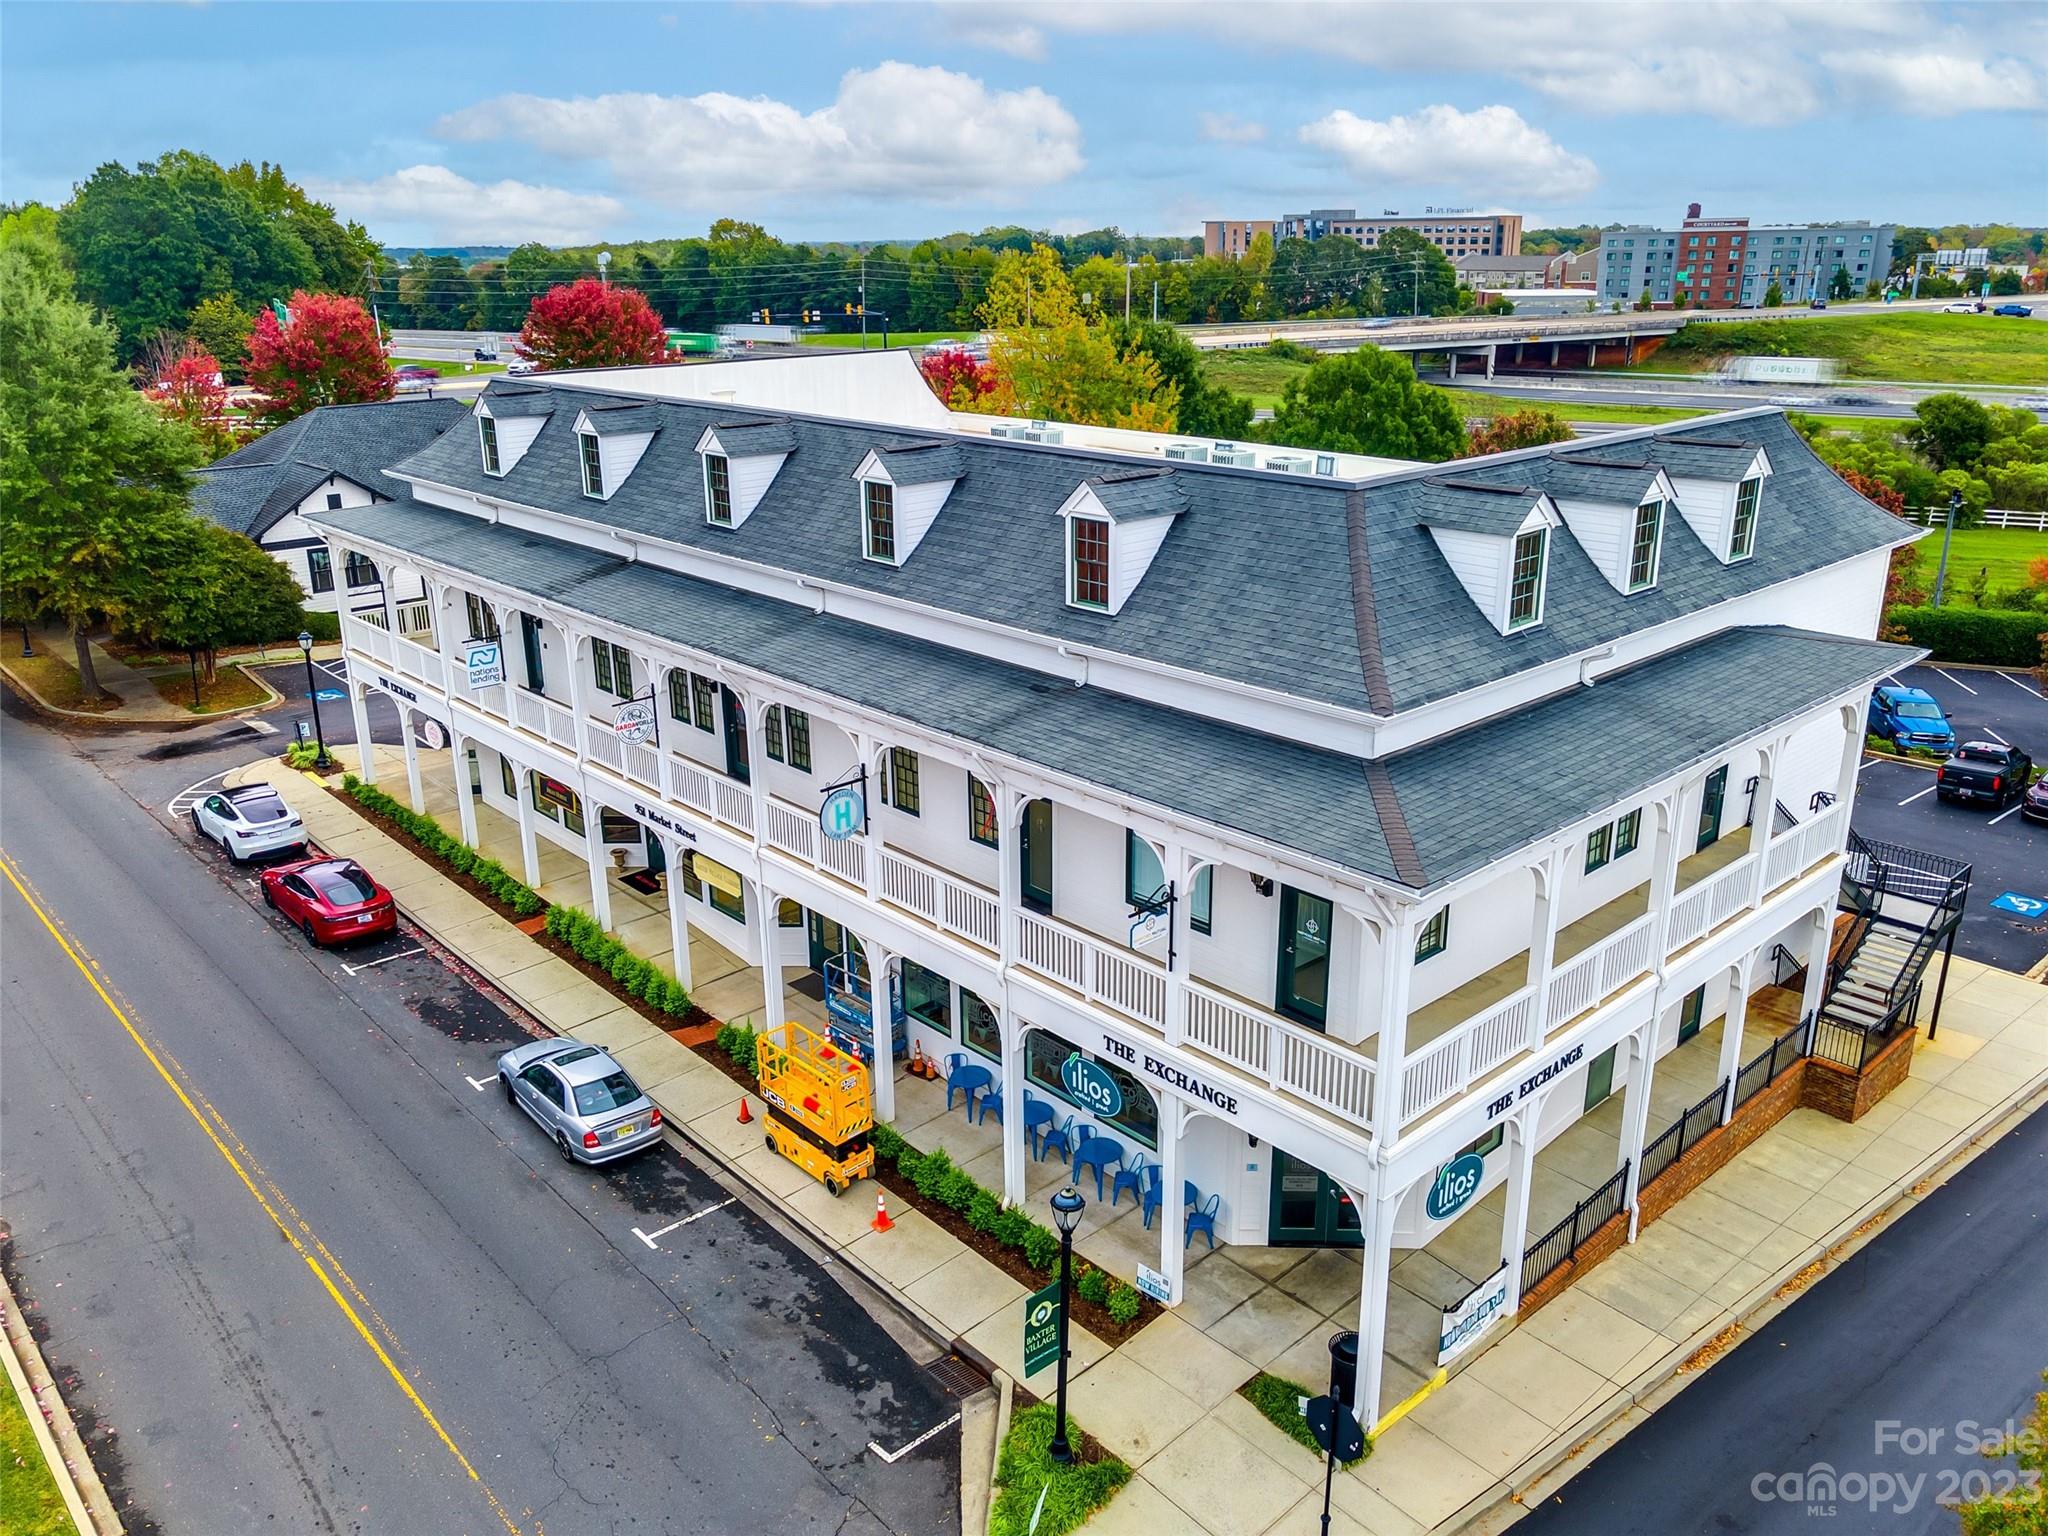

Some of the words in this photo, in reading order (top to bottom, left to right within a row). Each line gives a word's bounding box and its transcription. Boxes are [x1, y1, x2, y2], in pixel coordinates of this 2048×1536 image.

[470, 666, 500, 678] nations
[471, 673, 500, 684] lending
[647, 809, 672, 829] Market
[674, 823, 697, 842] Street
[835, 799, 851, 831] H
[1072, 1062, 1112, 1106] ilios
[1103, 1035, 1135, 1063] THE
[1144, 1055, 1238, 1115] EXCHANGE
[1486, 1091, 1513, 1120] THE
[1518, 1043, 1584, 1100] EXCHANGE
[762, 1088, 786, 1109] JCB
[1438, 1169, 1475, 1208] ilios
[1025, 1332, 1057, 1354] VILLAGE
[1026, 1324, 1056, 1345] BAXTER
